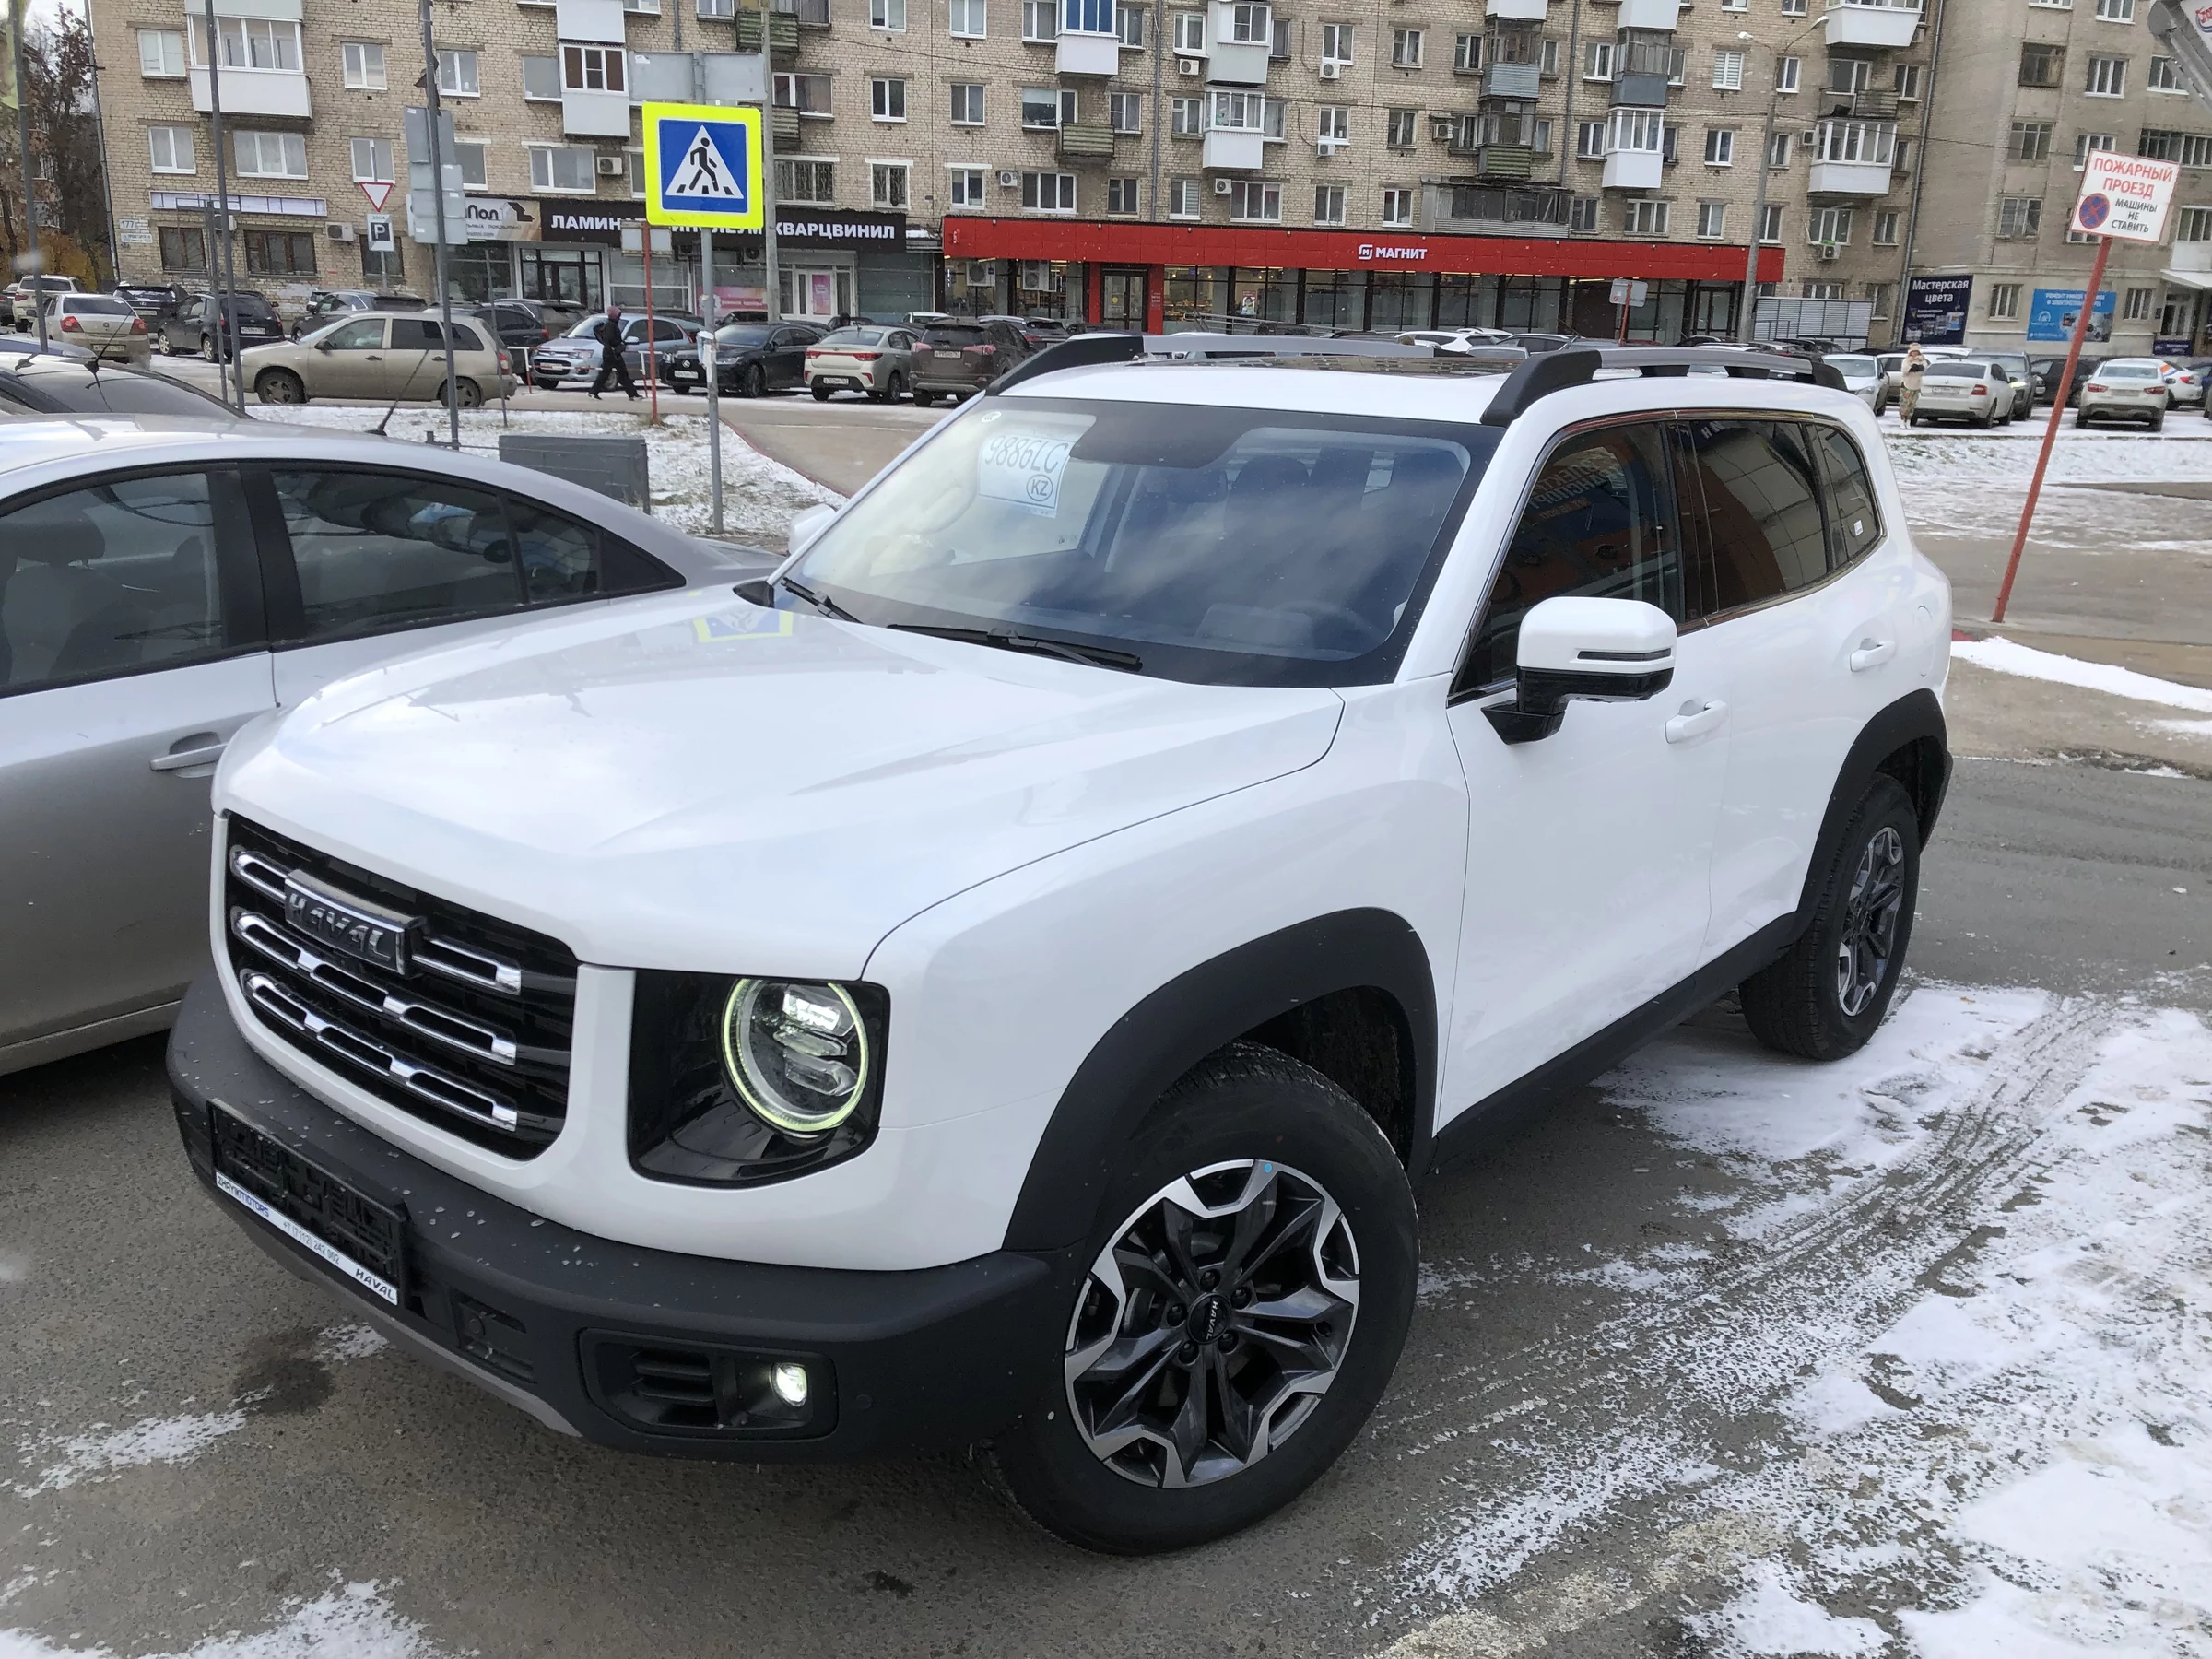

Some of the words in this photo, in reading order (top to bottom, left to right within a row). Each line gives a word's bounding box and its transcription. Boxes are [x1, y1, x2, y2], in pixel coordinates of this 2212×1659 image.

[2094, 158, 2173, 182] ПОЖАРНЫЙ
[2102, 177, 2155, 200] ПРОЕЗД
[2115, 198, 2158, 213] МАШИНЫ
[551, 214, 646, 230] ЛАМИН
[2127, 211, 2140, 221] НЕ
[2111, 219, 2149, 233] СТАВИТЬ
[1375, 247, 1428, 260] МАГНИТ
[1912, 279, 1970, 292] Мастерская
[1924, 293, 1954, 305] цвета
[984, 434, 1069, 474] 9886LC
[1030, 478, 1050, 497] KZ
[288, 892, 392, 962] HAVAL
[355, 1267, 395, 1301] HAVAL
[1206, 1300, 1218, 1341] HAVAL
